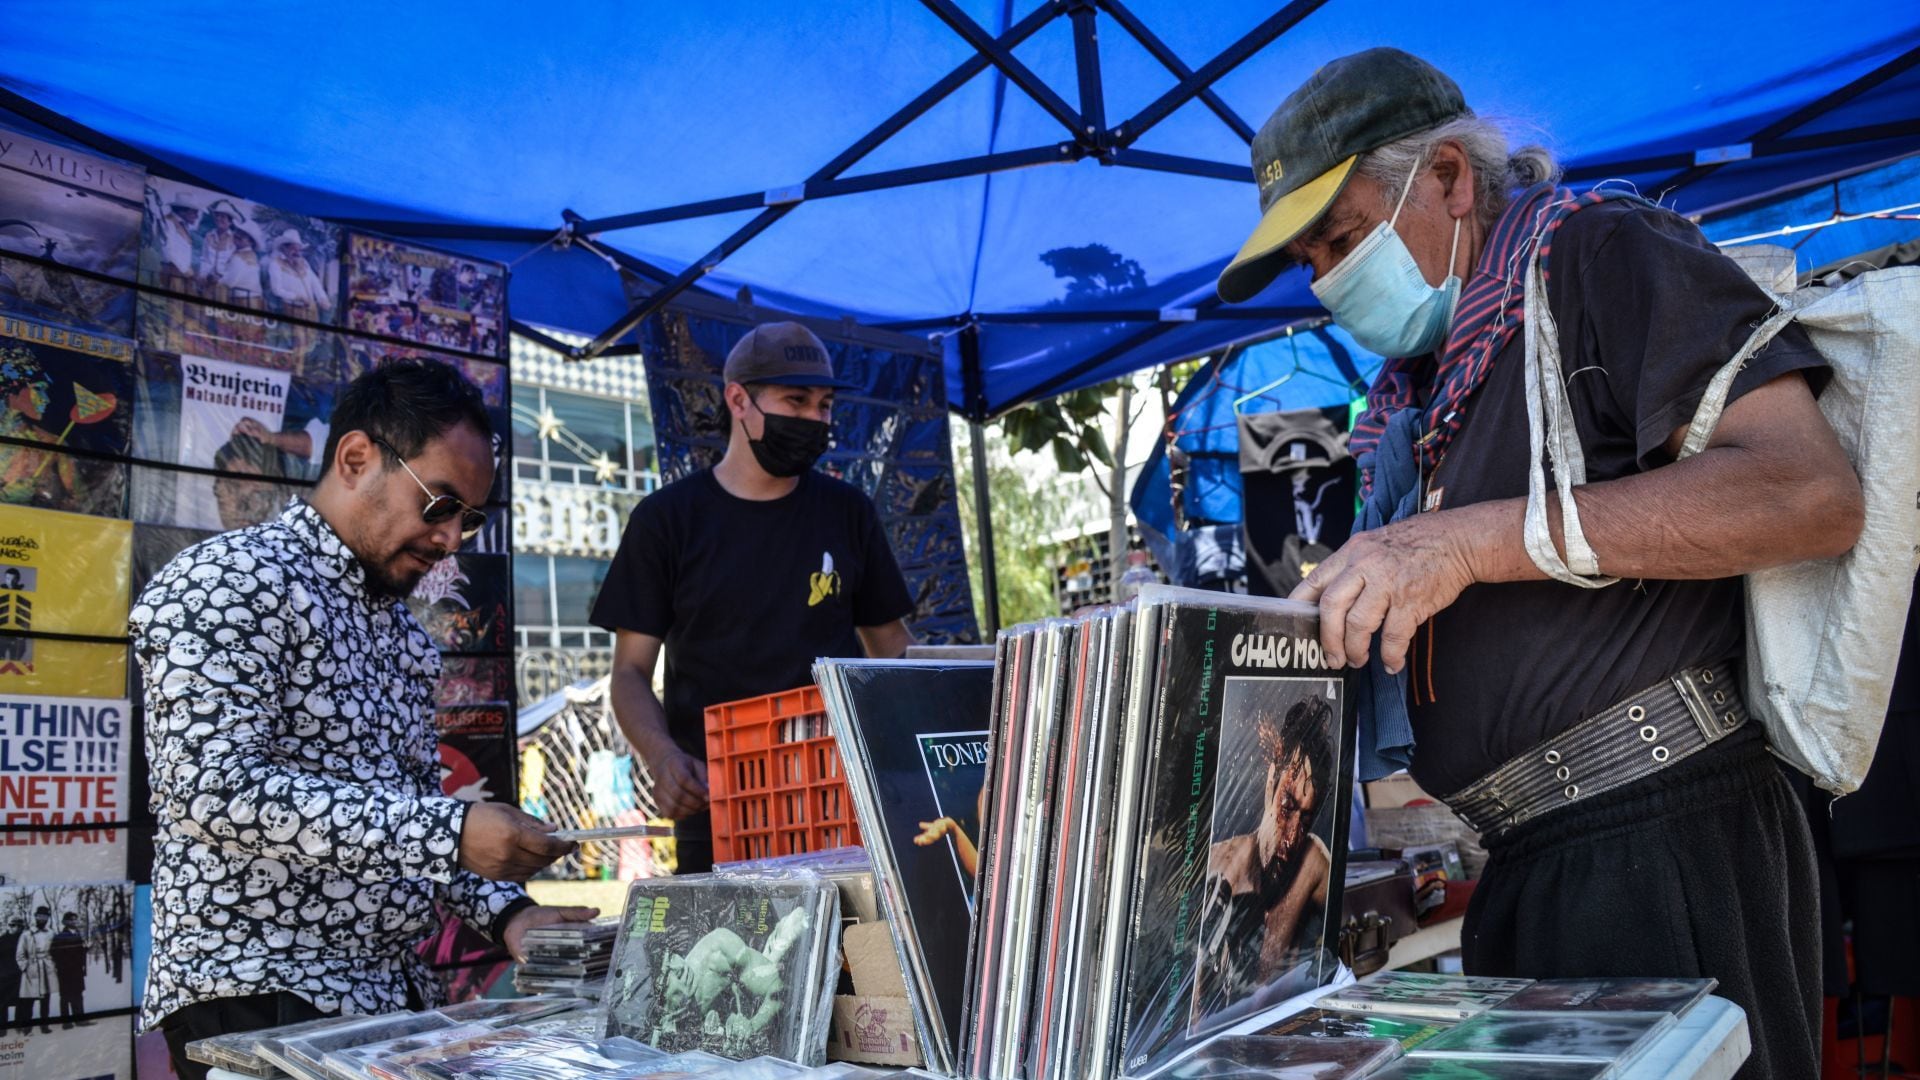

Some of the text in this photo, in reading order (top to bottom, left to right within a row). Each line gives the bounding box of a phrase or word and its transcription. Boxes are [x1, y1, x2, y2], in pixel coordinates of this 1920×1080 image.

[29, 148, 125, 191] MUSIC
[185, 363, 283, 398] Brujeria
[1230, 633, 1291, 669] CHAC
[0, 775, 117, 809] NETTE
[0, 811, 117, 846] EMAN
